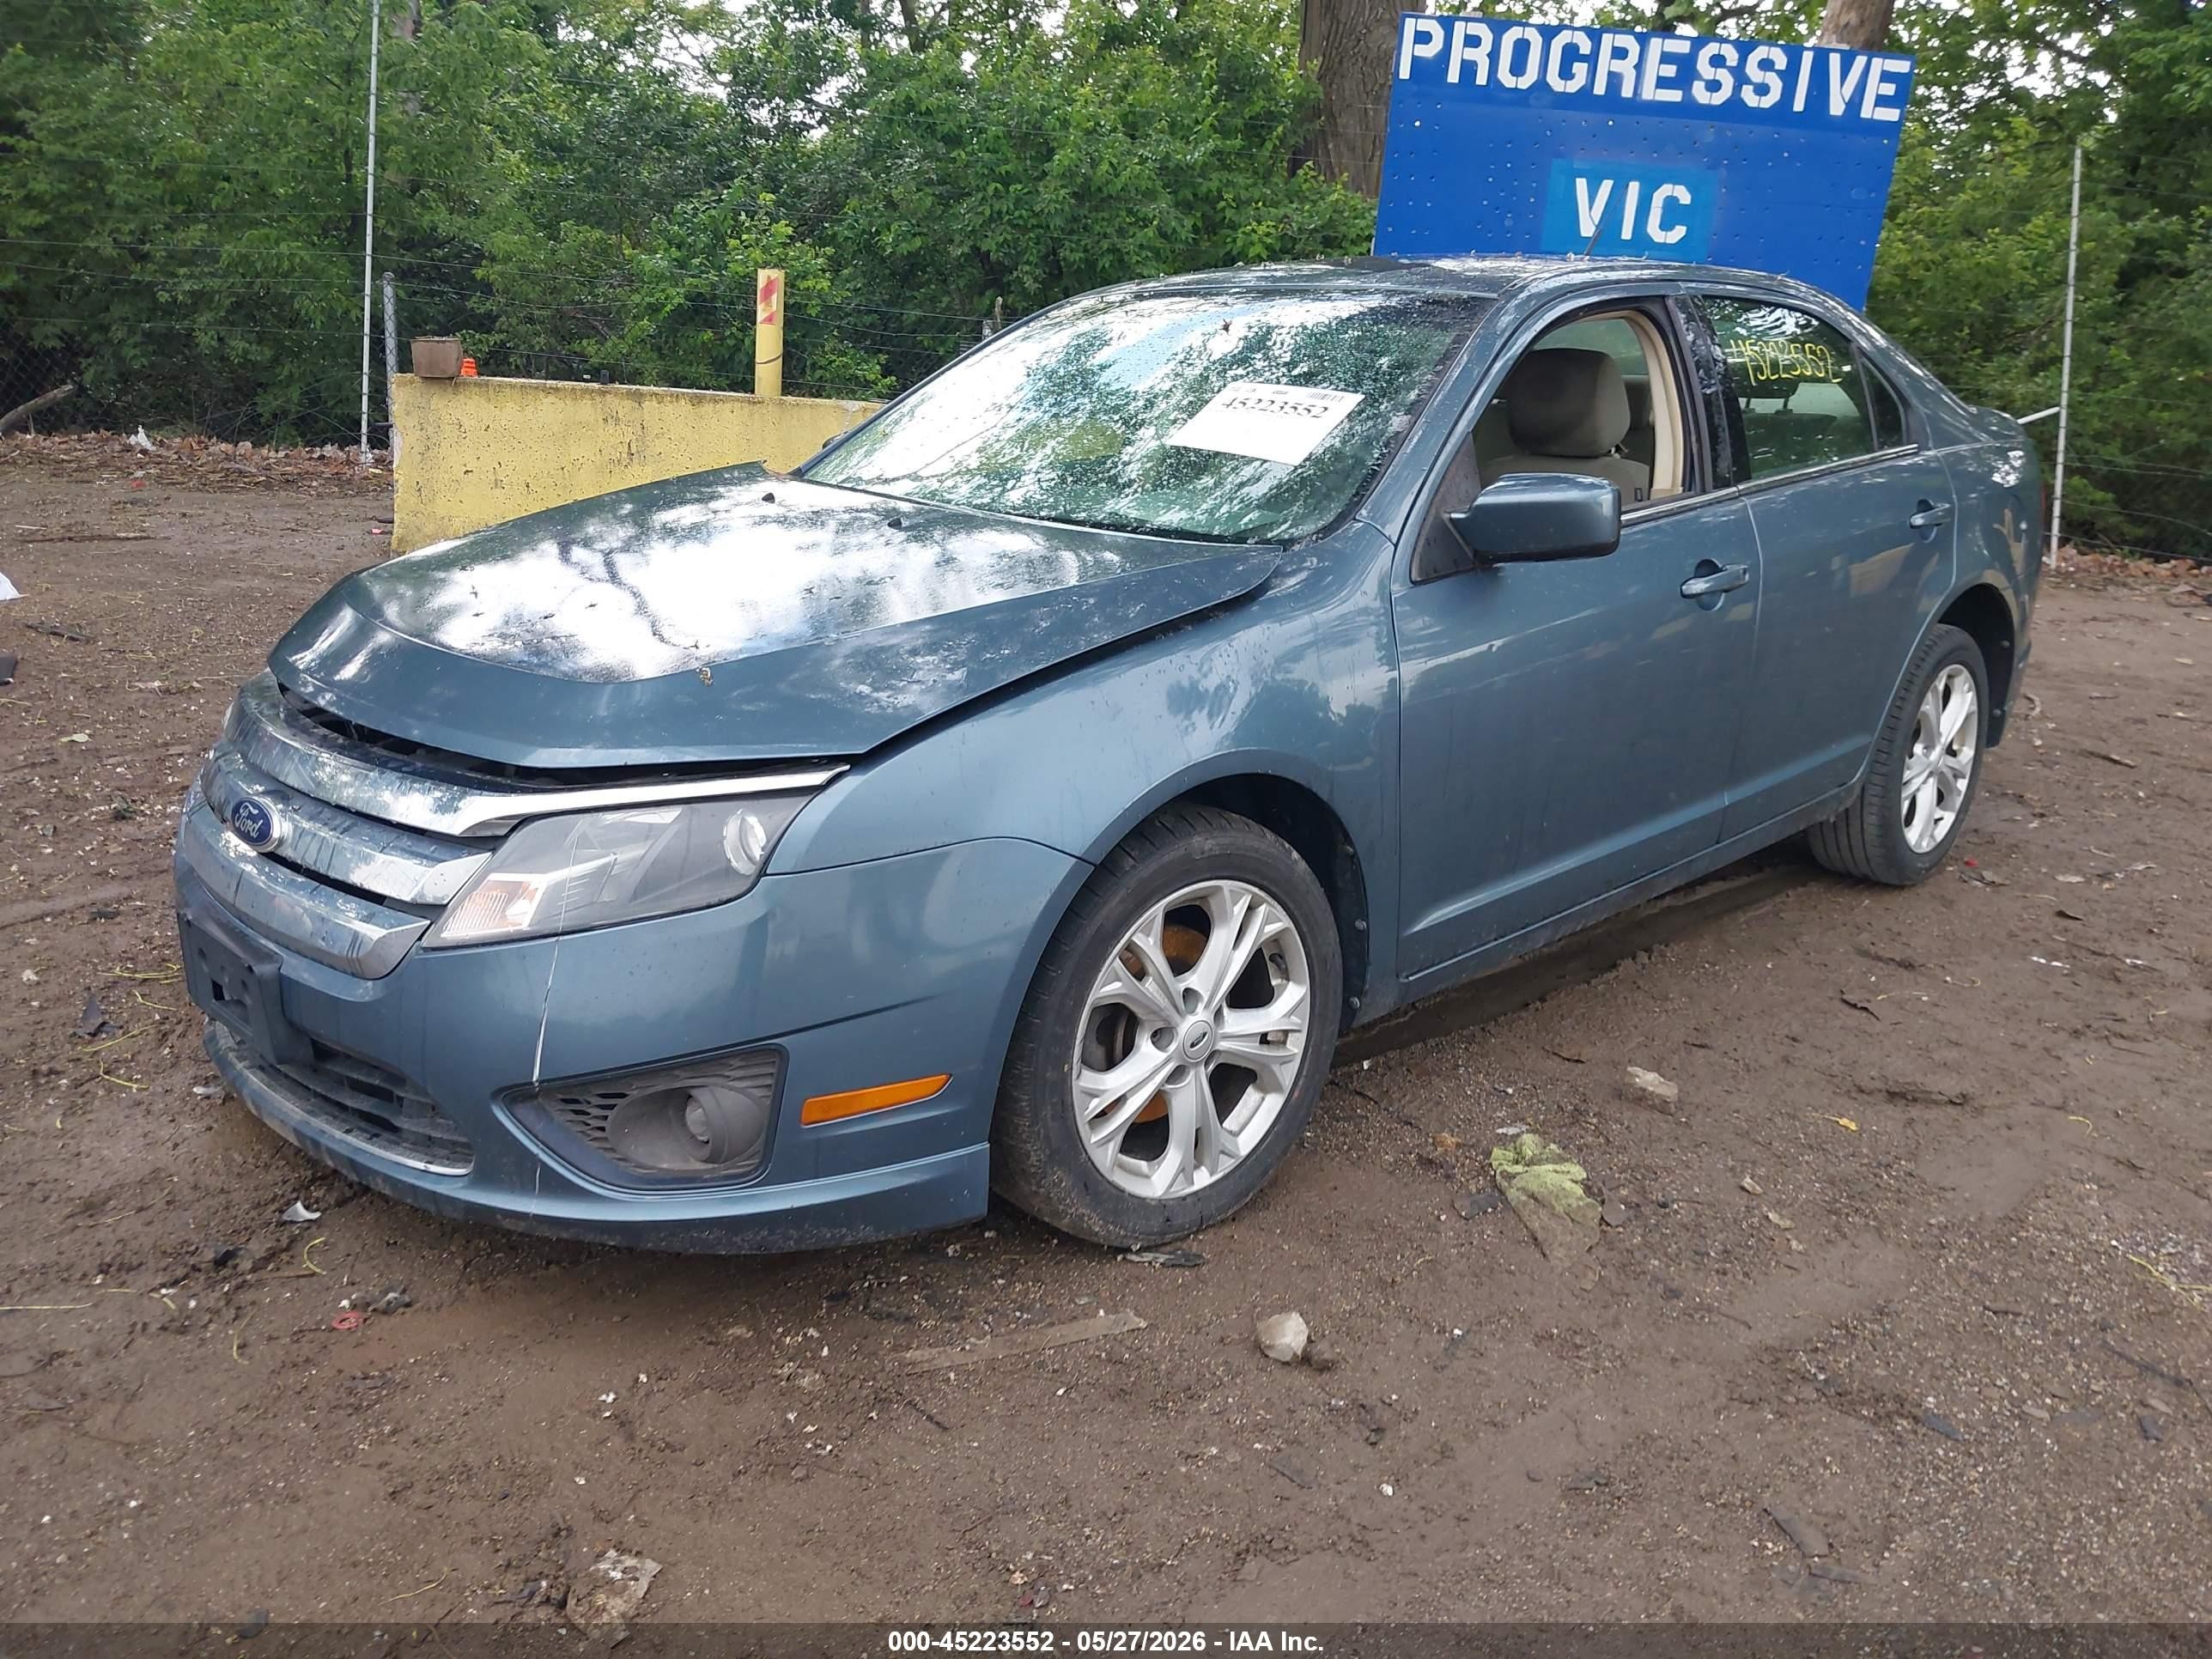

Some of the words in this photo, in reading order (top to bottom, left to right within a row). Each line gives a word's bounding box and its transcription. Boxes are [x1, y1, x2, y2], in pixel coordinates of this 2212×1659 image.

[1399, 17, 1911, 122] PROGRESSIVE
[1575, 177, 1692, 245] VIC
[1222, 397, 1329, 418] 45223552
[234, 801, 264, 839] Ford
